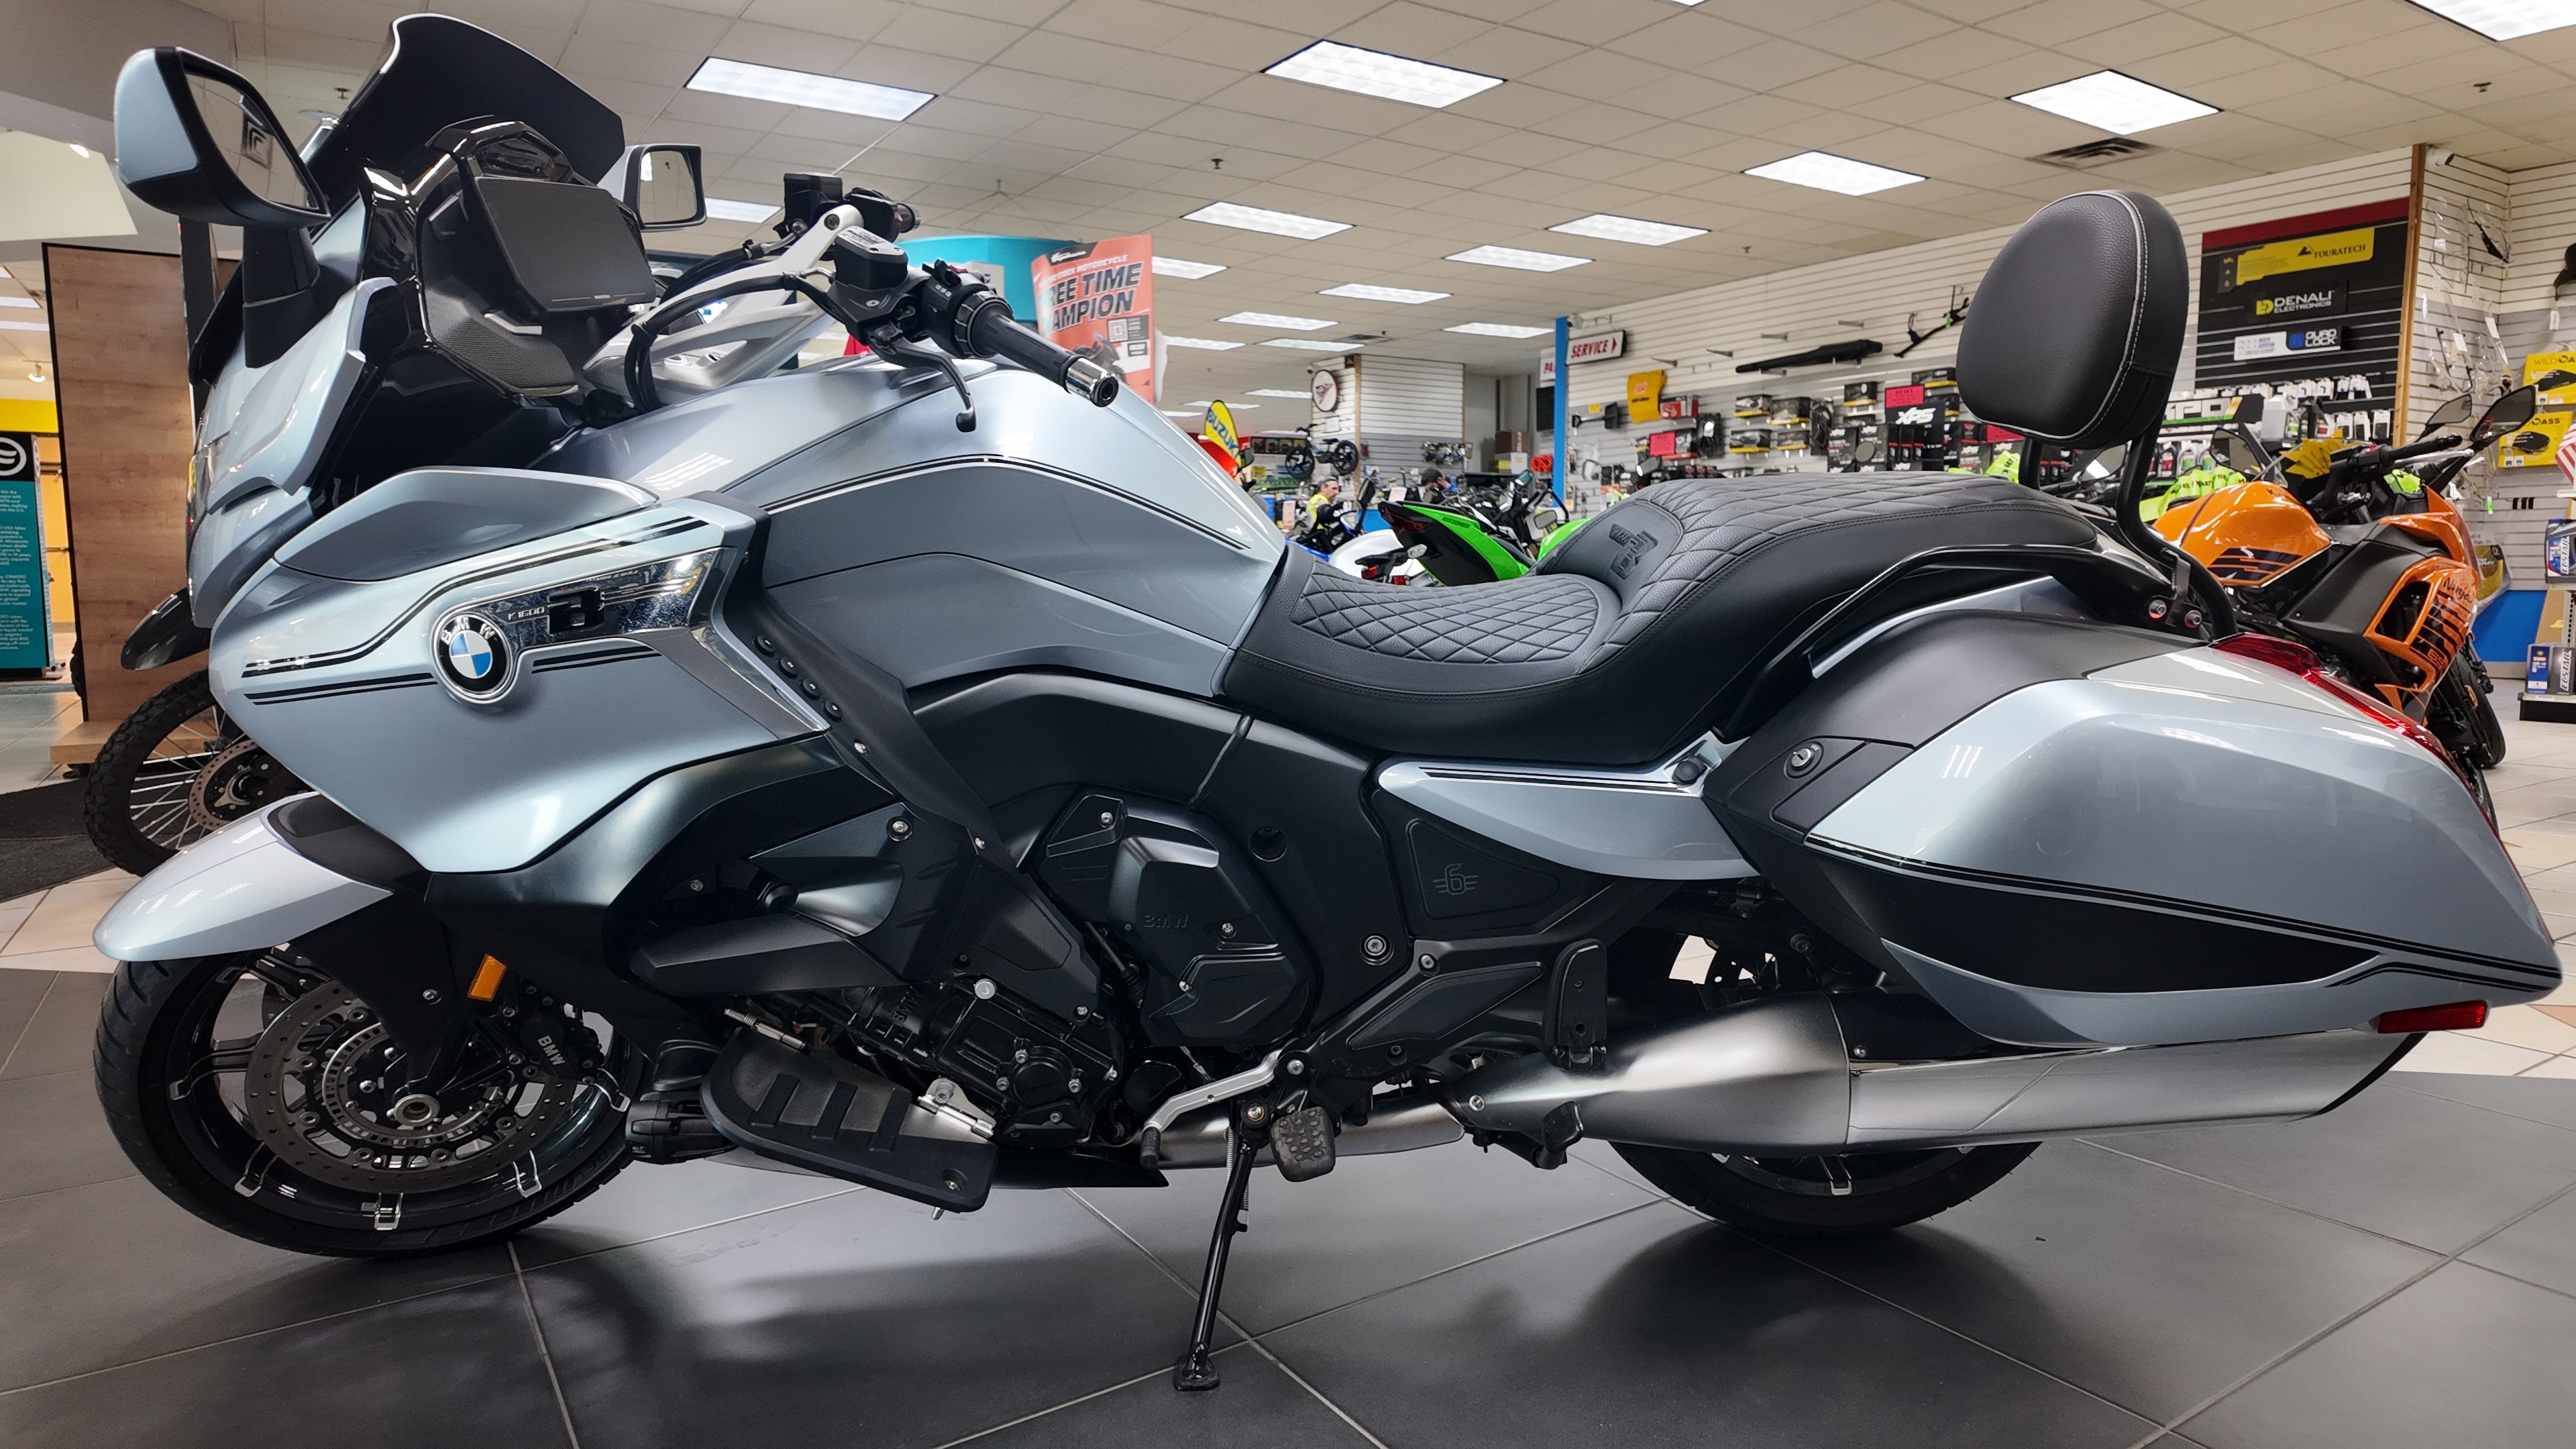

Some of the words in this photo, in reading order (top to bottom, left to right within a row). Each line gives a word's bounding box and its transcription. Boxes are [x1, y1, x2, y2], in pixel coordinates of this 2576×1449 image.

[2314, 244, 2366, 259] TOURATECH
[1081, 262, 1144, 297] TIME
[2274, 290, 2332, 307] DENALI
[2274, 301, 2332, 314] ELECTRONICS
[1570, 340, 1609, 358] SERVICE
[2305, 337, 2336, 347] LOCK
[1895, 407, 1937, 425] XPS
[2443, 576, 2472, 604] Ninja
[440, 616, 496, 645] BMW
[2561, 653, 2570, 690] ECSTAR
[1142, 914, 1189, 928] BMW
[537, 1035, 566, 1065] BMW
